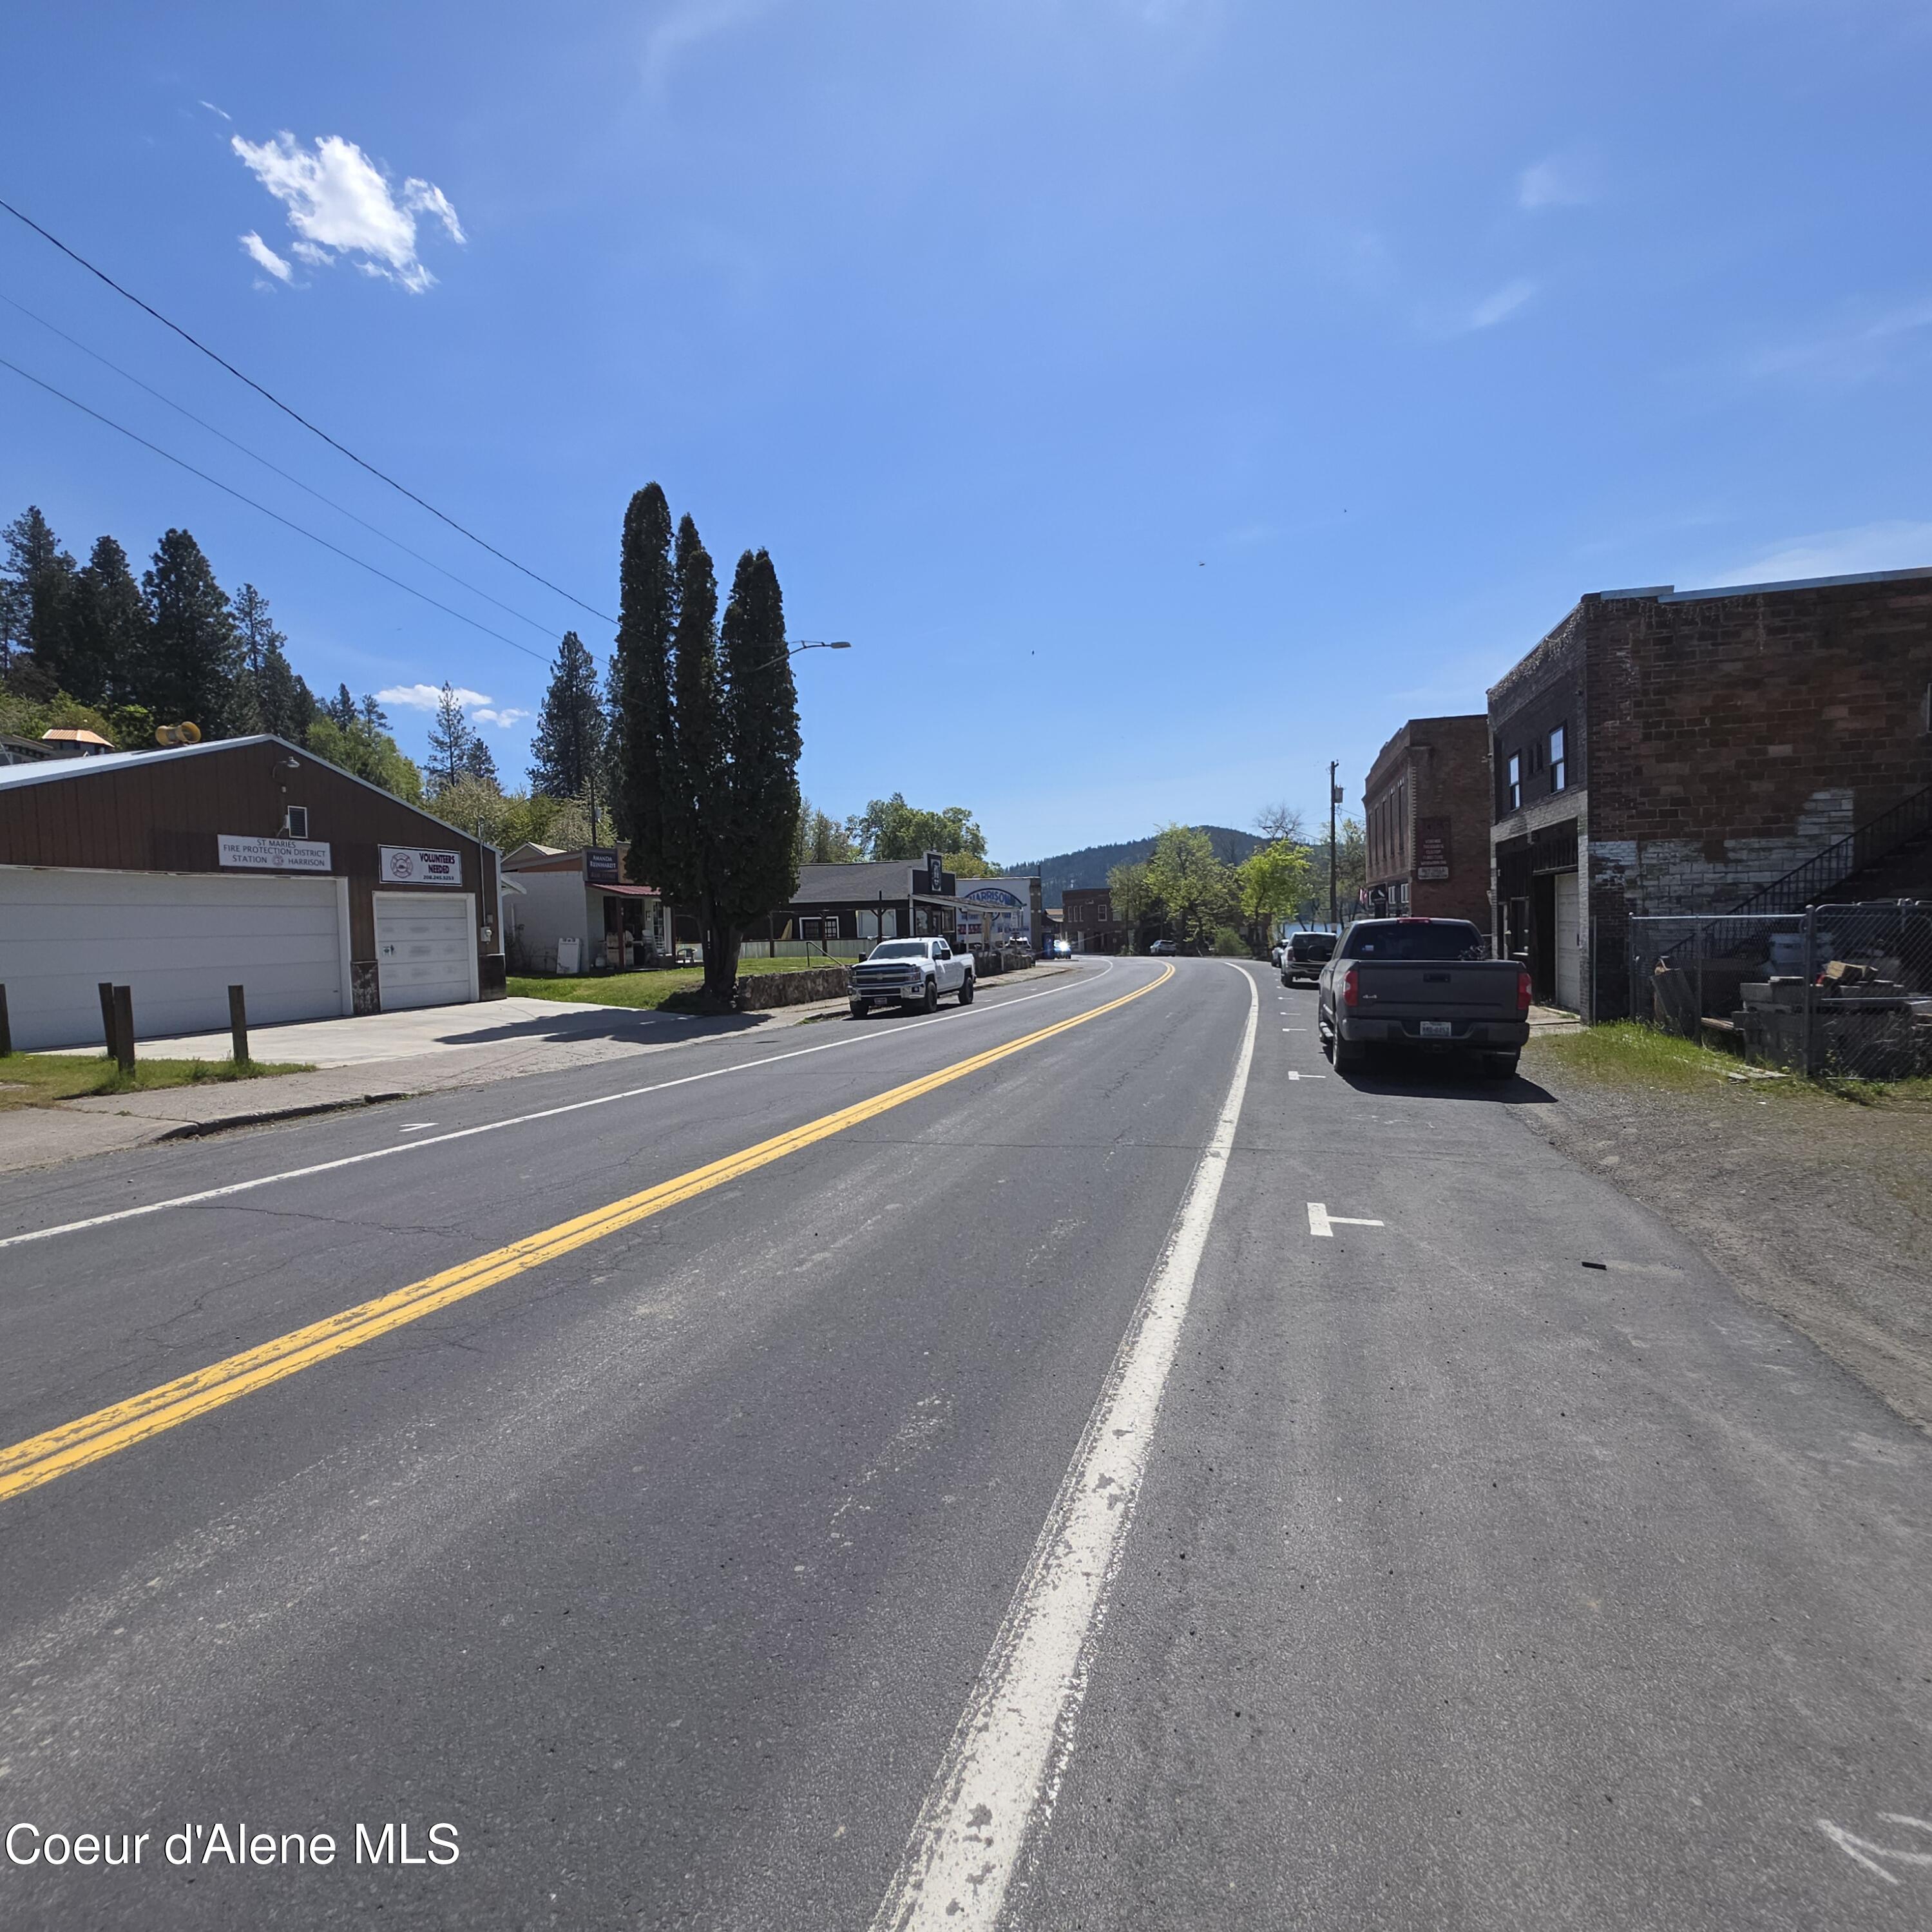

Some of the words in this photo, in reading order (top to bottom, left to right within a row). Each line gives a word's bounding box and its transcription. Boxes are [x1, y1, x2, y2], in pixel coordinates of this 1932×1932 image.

[223, 844, 240, 852] FIRE
[243, 845, 292, 855] PROTECTION
[269, 840, 296, 848] MARIES
[233, 854, 267, 863] STATION
[288, 857, 325, 866] HARRISON
[419, 852, 455, 864] VOLUNTEERS
[428, 864, 450, 874] NEEDED
